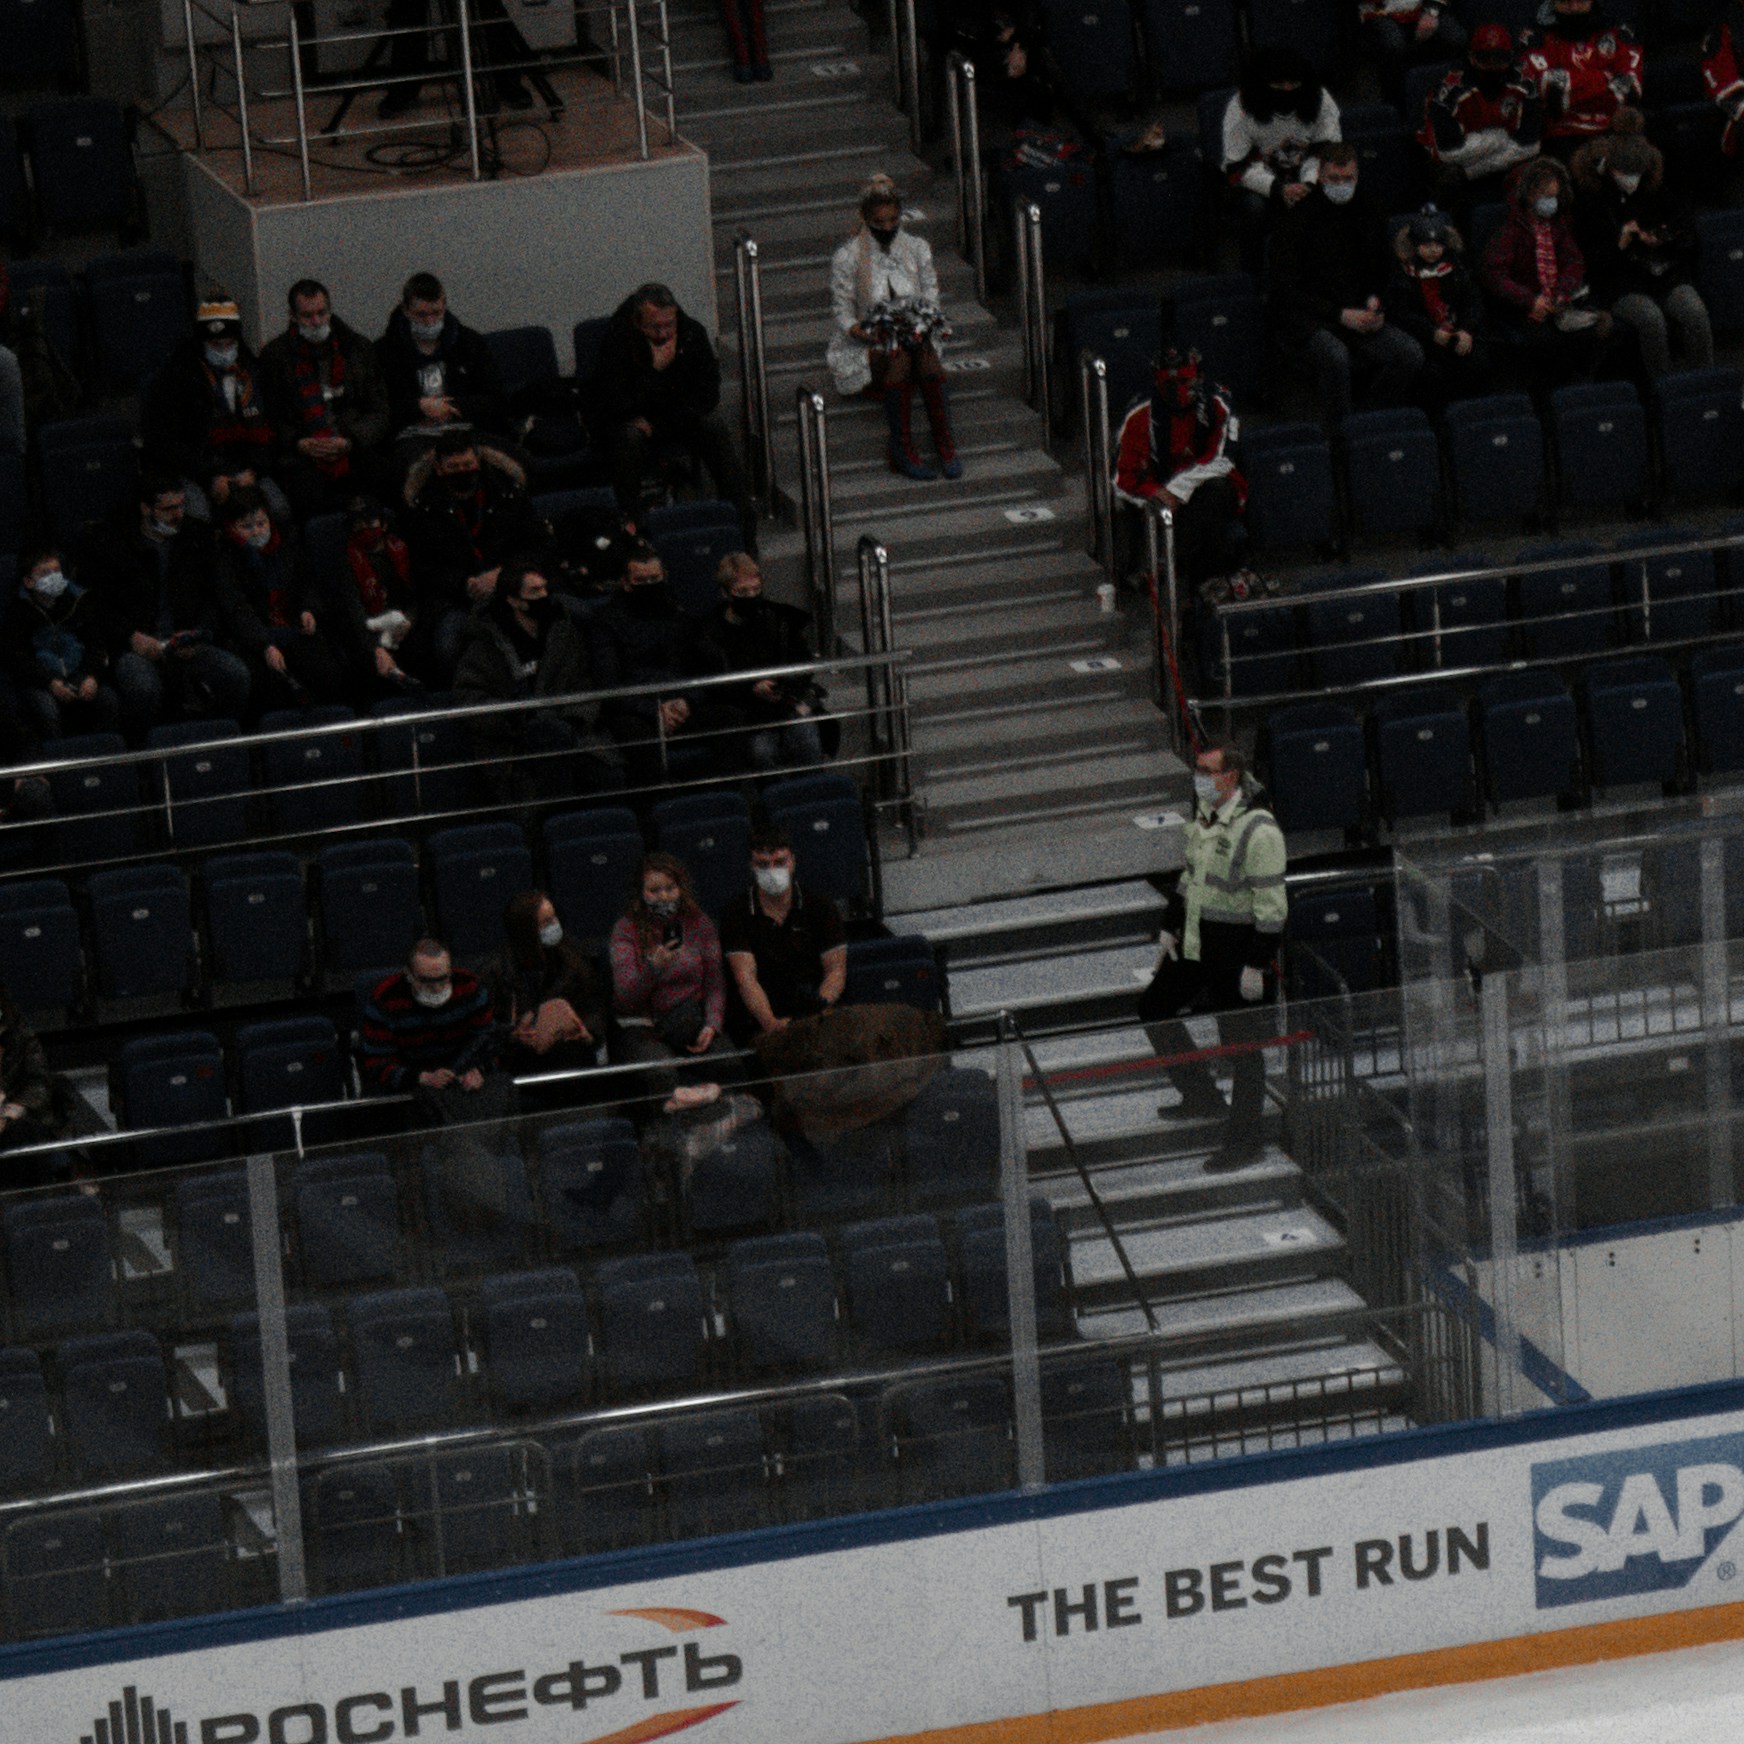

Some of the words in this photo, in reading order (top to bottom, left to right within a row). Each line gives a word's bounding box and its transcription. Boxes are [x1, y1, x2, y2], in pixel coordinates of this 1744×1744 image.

[1007, 1577, 1142, 1643] THE
[1163, 1546, 1333, 1620] BEST
[1354, 1522, 1491, 1591] RUN
